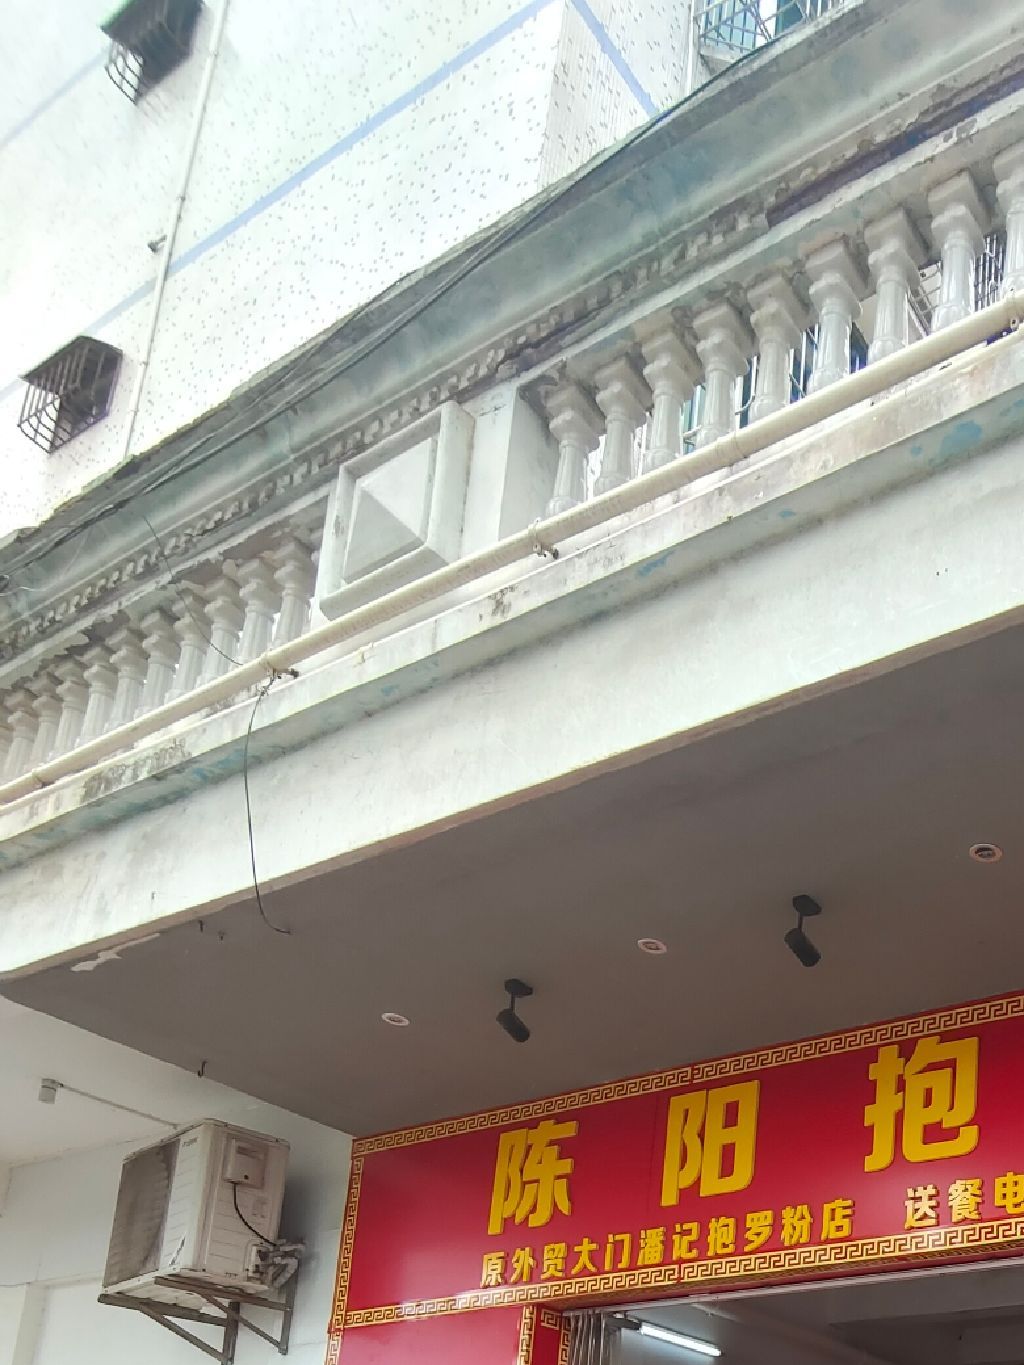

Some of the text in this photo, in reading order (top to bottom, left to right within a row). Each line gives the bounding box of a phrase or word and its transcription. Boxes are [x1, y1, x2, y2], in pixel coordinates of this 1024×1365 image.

[480, 1198, 856, 1289] 原外贸大门潘记抱罗粉店
